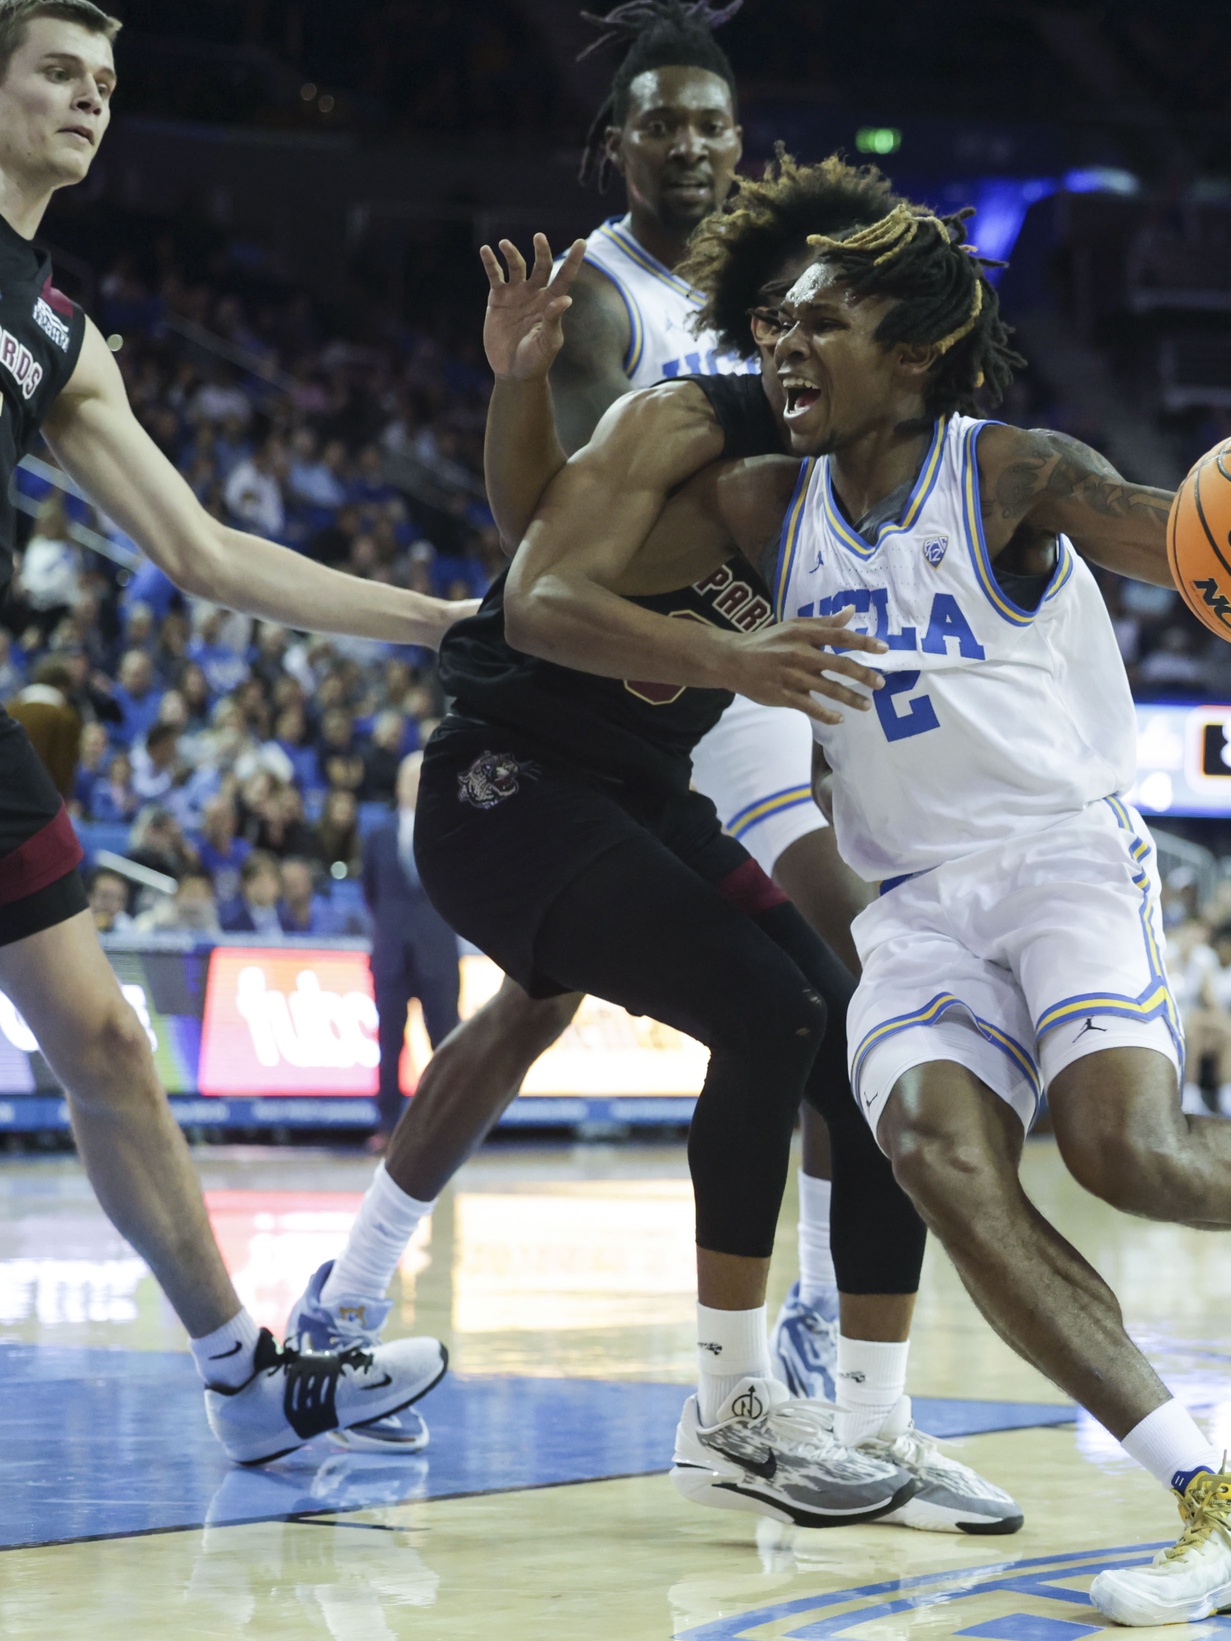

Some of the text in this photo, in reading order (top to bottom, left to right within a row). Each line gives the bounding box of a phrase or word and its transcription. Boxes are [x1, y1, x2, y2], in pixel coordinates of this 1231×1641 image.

[0, 325, 43, 400] RDS
[924, 536, 949, 556] PAC
[928, 548, 942, 562] 12
[692, 563, 776, 633] PAR
[870, 667, 941, 742] 2
